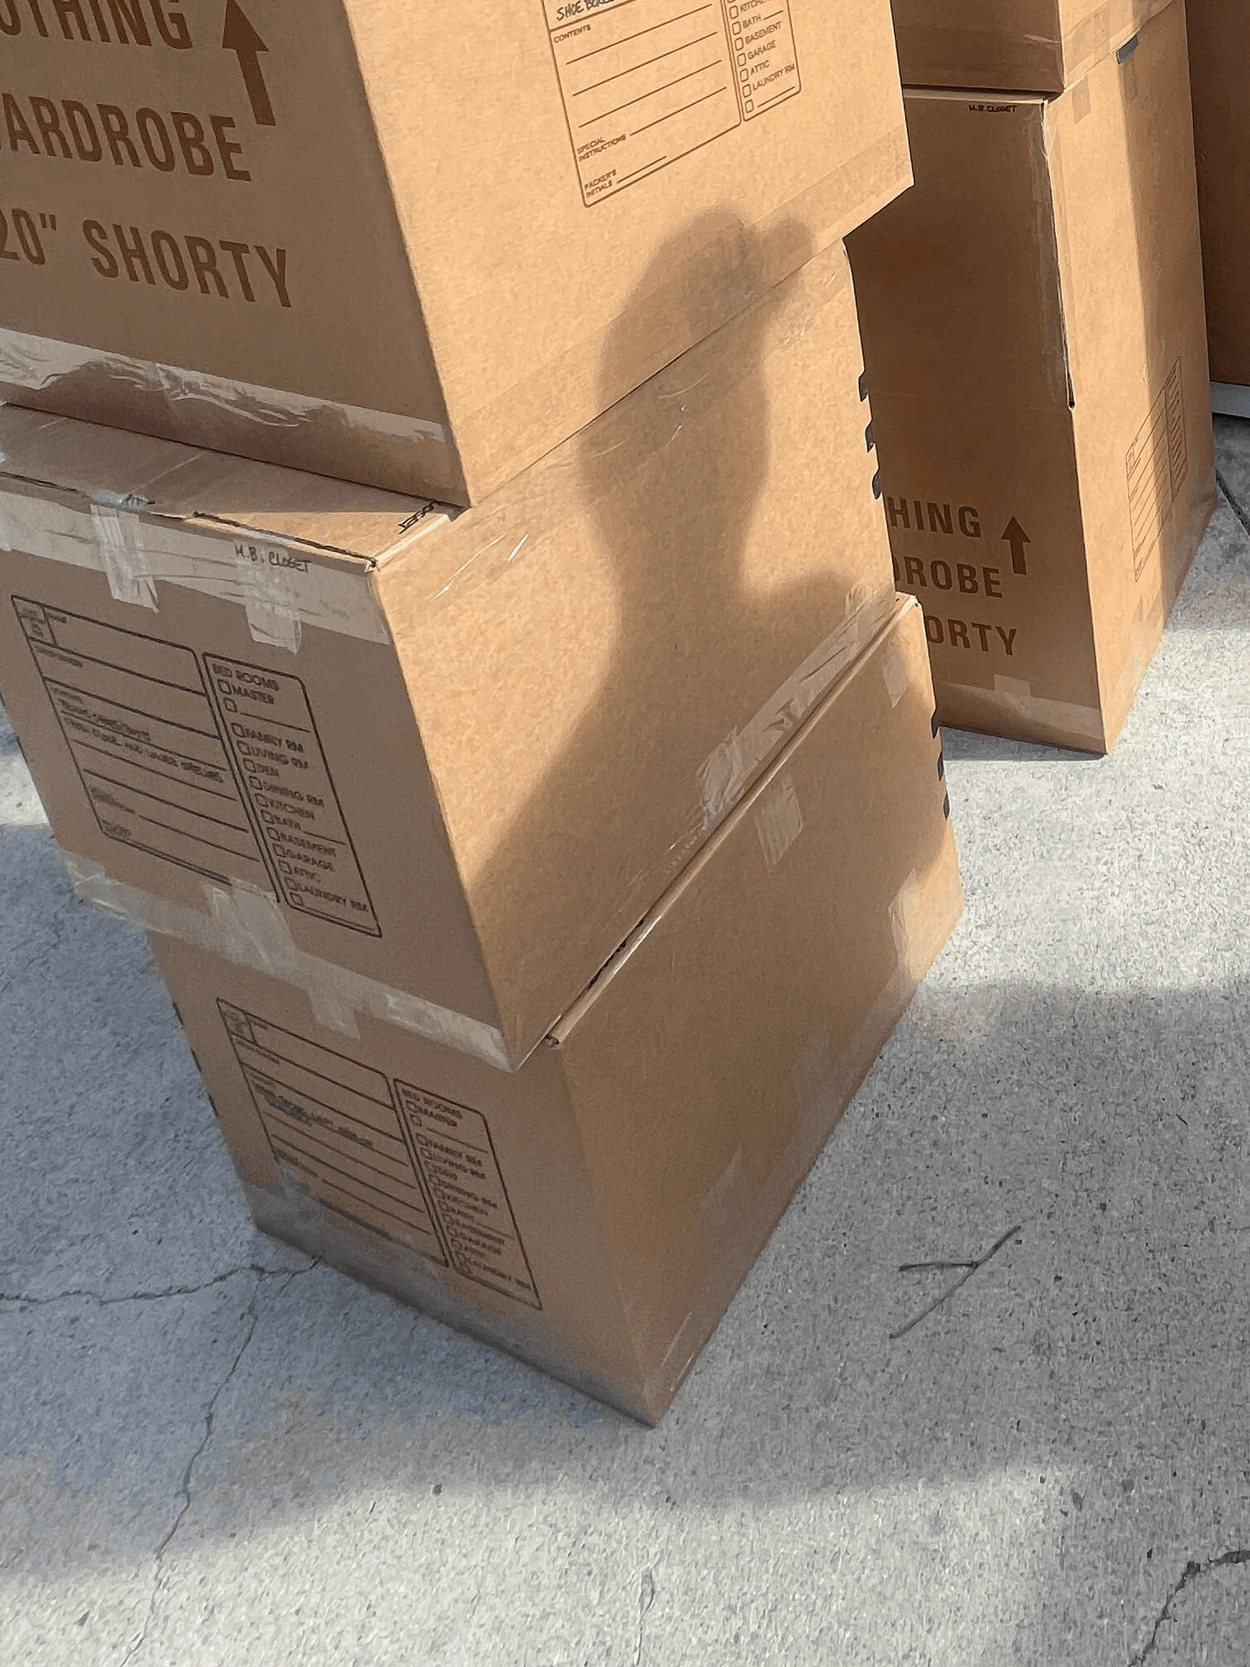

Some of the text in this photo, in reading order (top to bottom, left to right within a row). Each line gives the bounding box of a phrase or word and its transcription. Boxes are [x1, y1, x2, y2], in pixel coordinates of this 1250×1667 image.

[556, 0, 584, 21] SHOE
[553, 24, 592, 44] CONTENTS
[745, 21, 782, 45] BASEMENT
[747, 40, 777, 60] GARAGE
[750, 59, 770, 76] ATTIC
[752, 69, 783, 91] LAUNDRY
[0, 92, 251, 182] ARDROBE
[82, 219, 292, 308] SHORTY
[268, 551, 312, 575] CLOSET
[235, 670, 279, 691] ROOMS
[232, 684, 275, 705] MASTER
